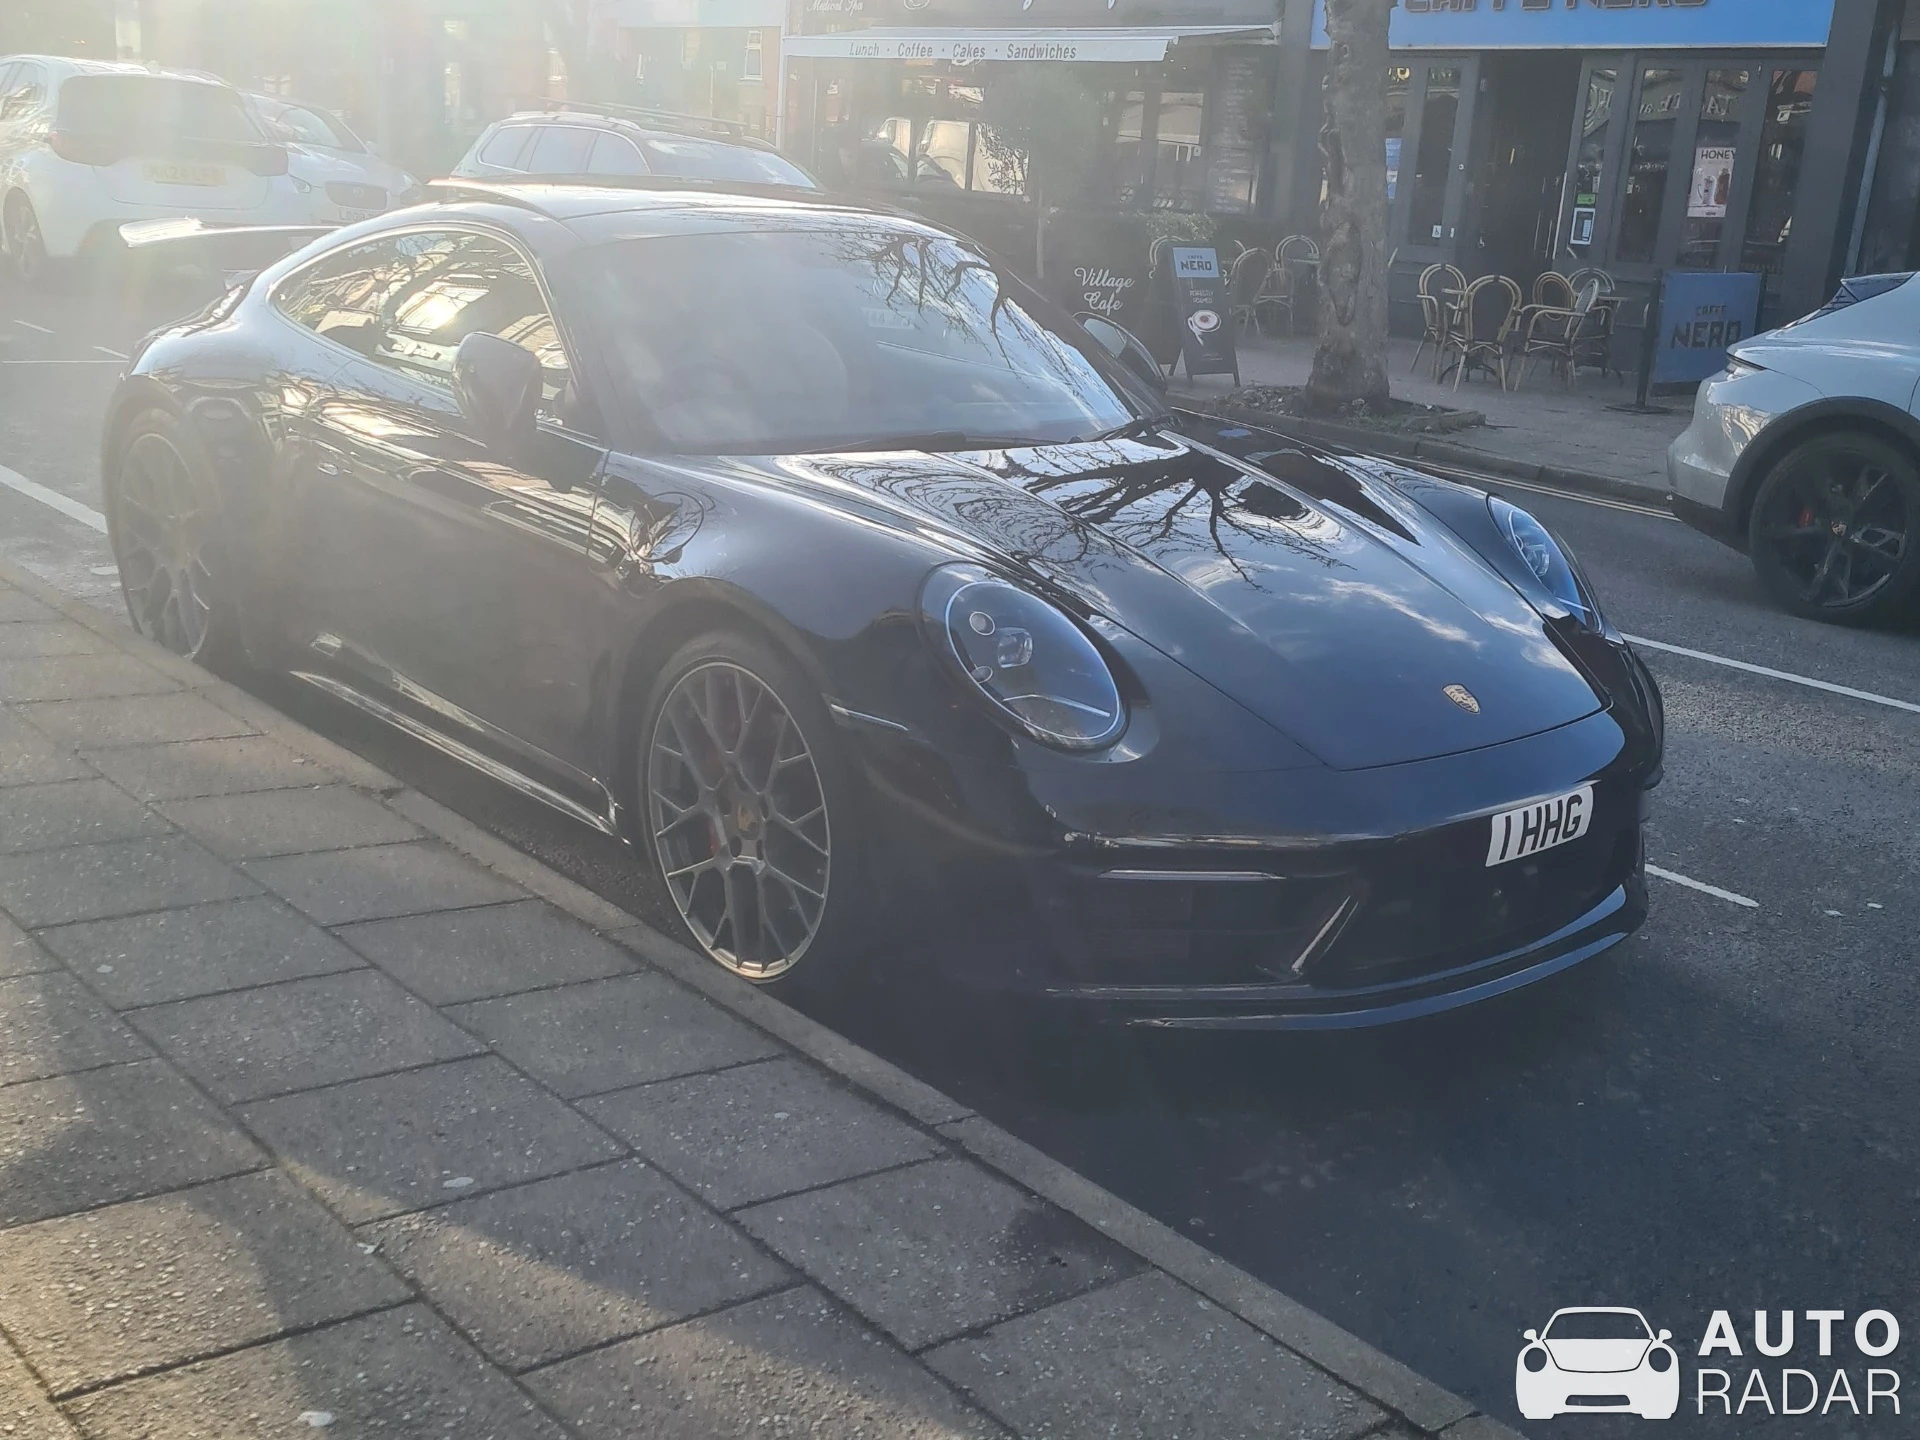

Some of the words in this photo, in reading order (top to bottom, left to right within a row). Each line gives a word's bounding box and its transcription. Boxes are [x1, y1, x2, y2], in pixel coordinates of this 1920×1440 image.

[849, 42, 880, 57] Lunch
[897, 43, 933, 57] Coffee
[952, 43, 986, 58] Cakes
[1006, 43, 1077, 60] Sandwiches
[1180, 260, 1213, 271] NERO
[1074, 267, 1135, 294] Village
[1083, 291, 1124, 317] Cafe
[1671, 320, 1742, 349] NERO
[1517, 794, 1583, 855] HHG
